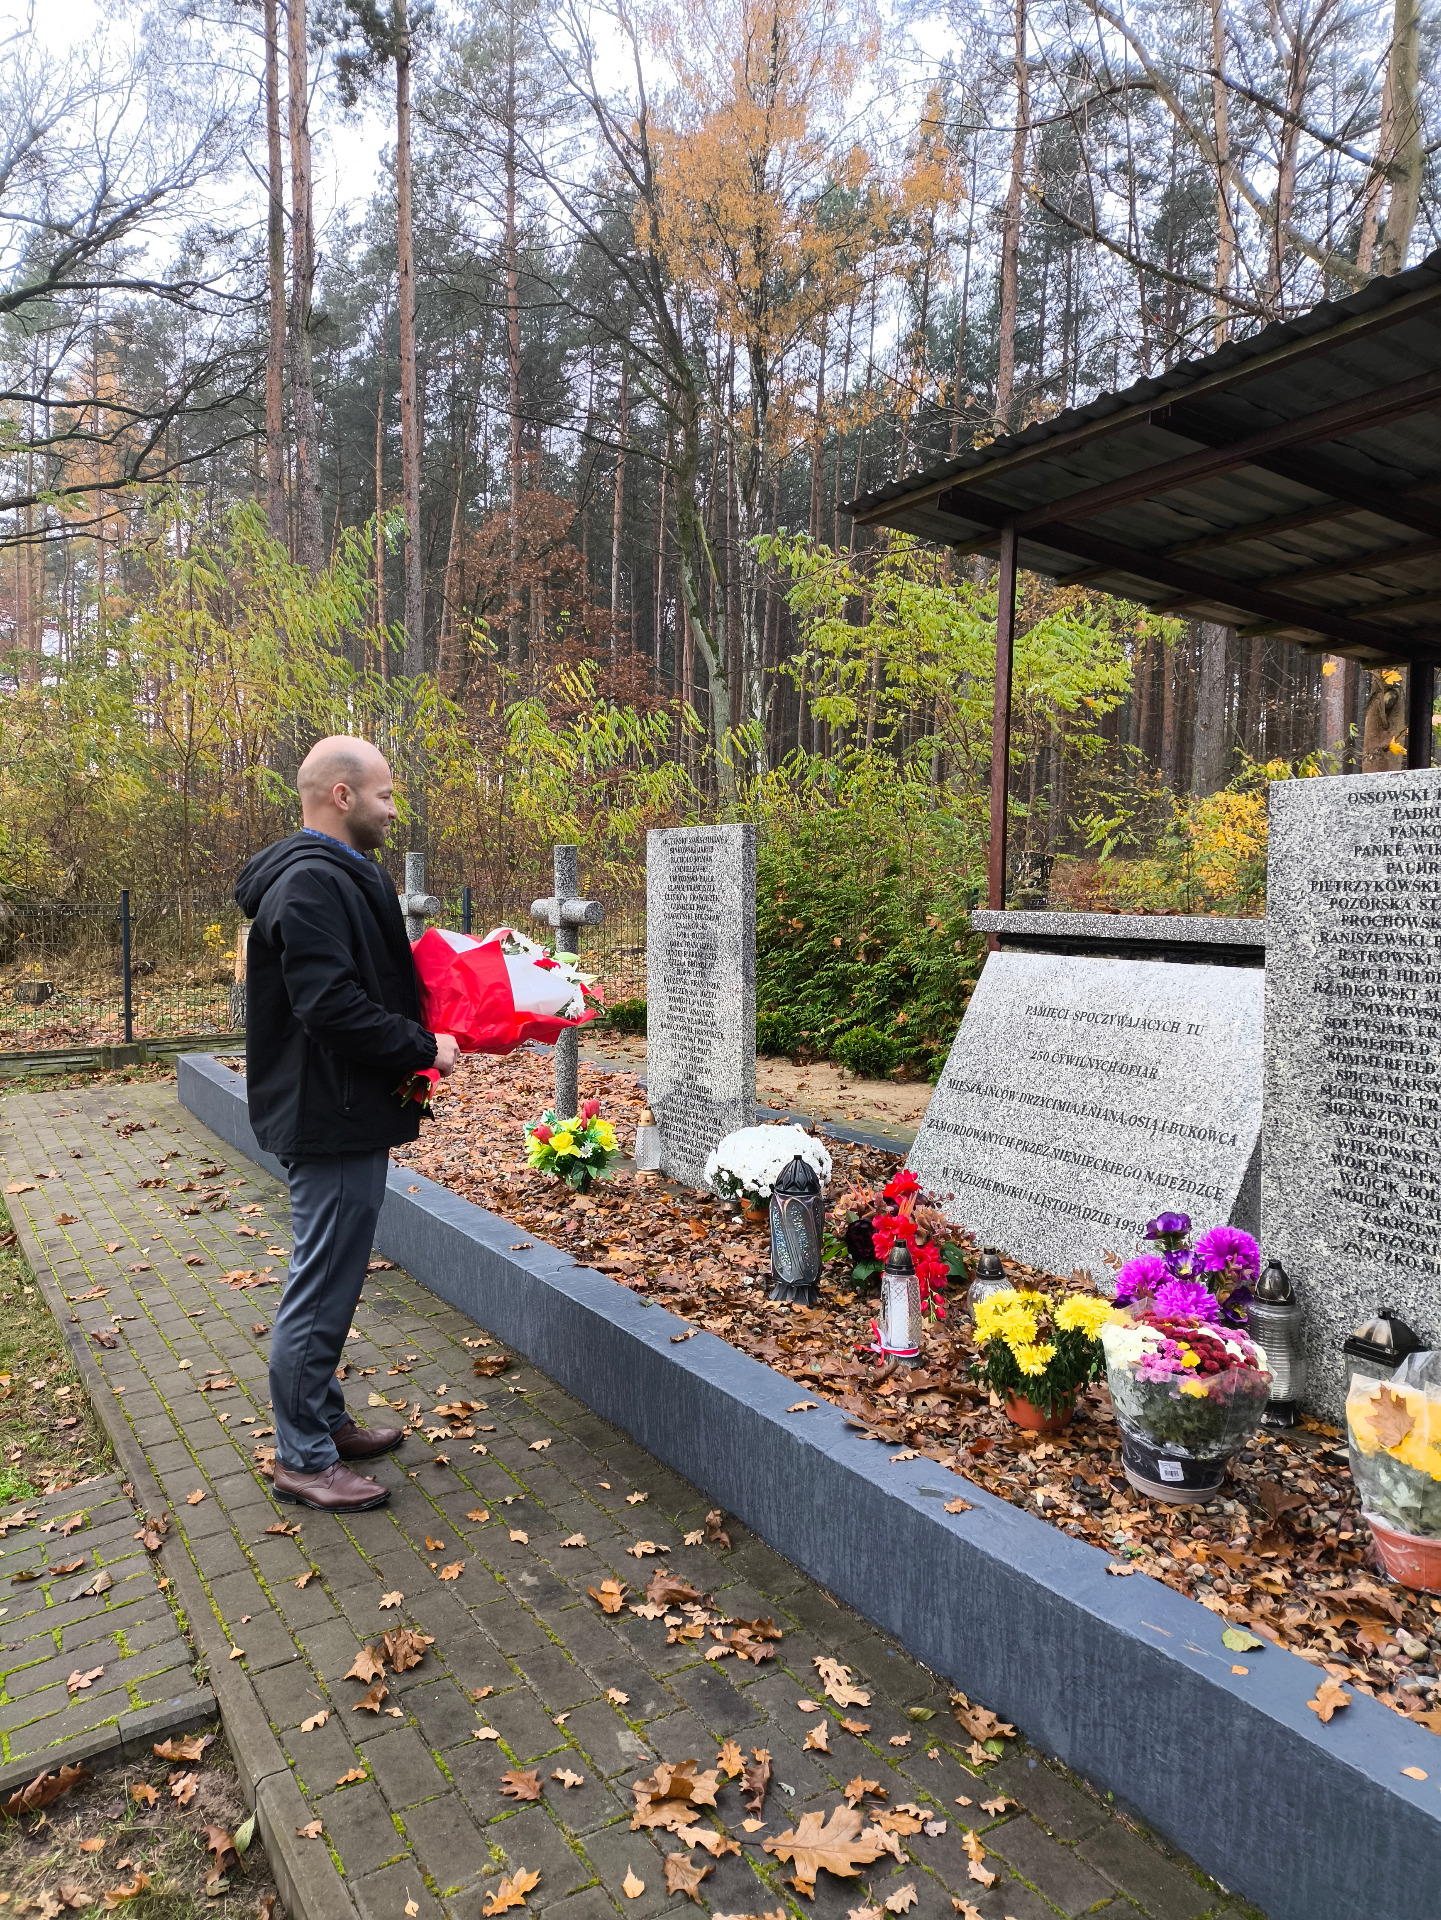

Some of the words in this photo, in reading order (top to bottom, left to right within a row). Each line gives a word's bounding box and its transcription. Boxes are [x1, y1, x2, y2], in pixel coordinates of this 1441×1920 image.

[1348, 789, 1430, 805] OSSOWSKI
[1353, 844, 1403, 858] PANKE
[1320, 931, 1425, 948] RANISZEWSKI
[1338, 949, 1432, 965] RATKOWSKI
[1187, 1022, 1205, 1036] TU
[1323, 1034, 1430, 1056] SOMMERFELD
[1029, 1050, 1050, 1062] 250
[1051, 1052, 1118, 1073] CYWILNYCH
[1119, 1063, 1159, 1080] OFIAR
[1168, 1122, 1238, 1147] BUKOWCA
[927, 1118, 1015, 1148] ZAMORDOWANYCH
[1015, 1138, 1051, 1157] PRZEZ
[1050, 1146, 1142, 1180] NIEMIECKIEGO
[1336, 1138, 1431, 1165] WITKOWSKI
[1034, 1191, 1112, 1226] LISTOPADZIE
[1115, 1216, 1146, 1236] 1939
